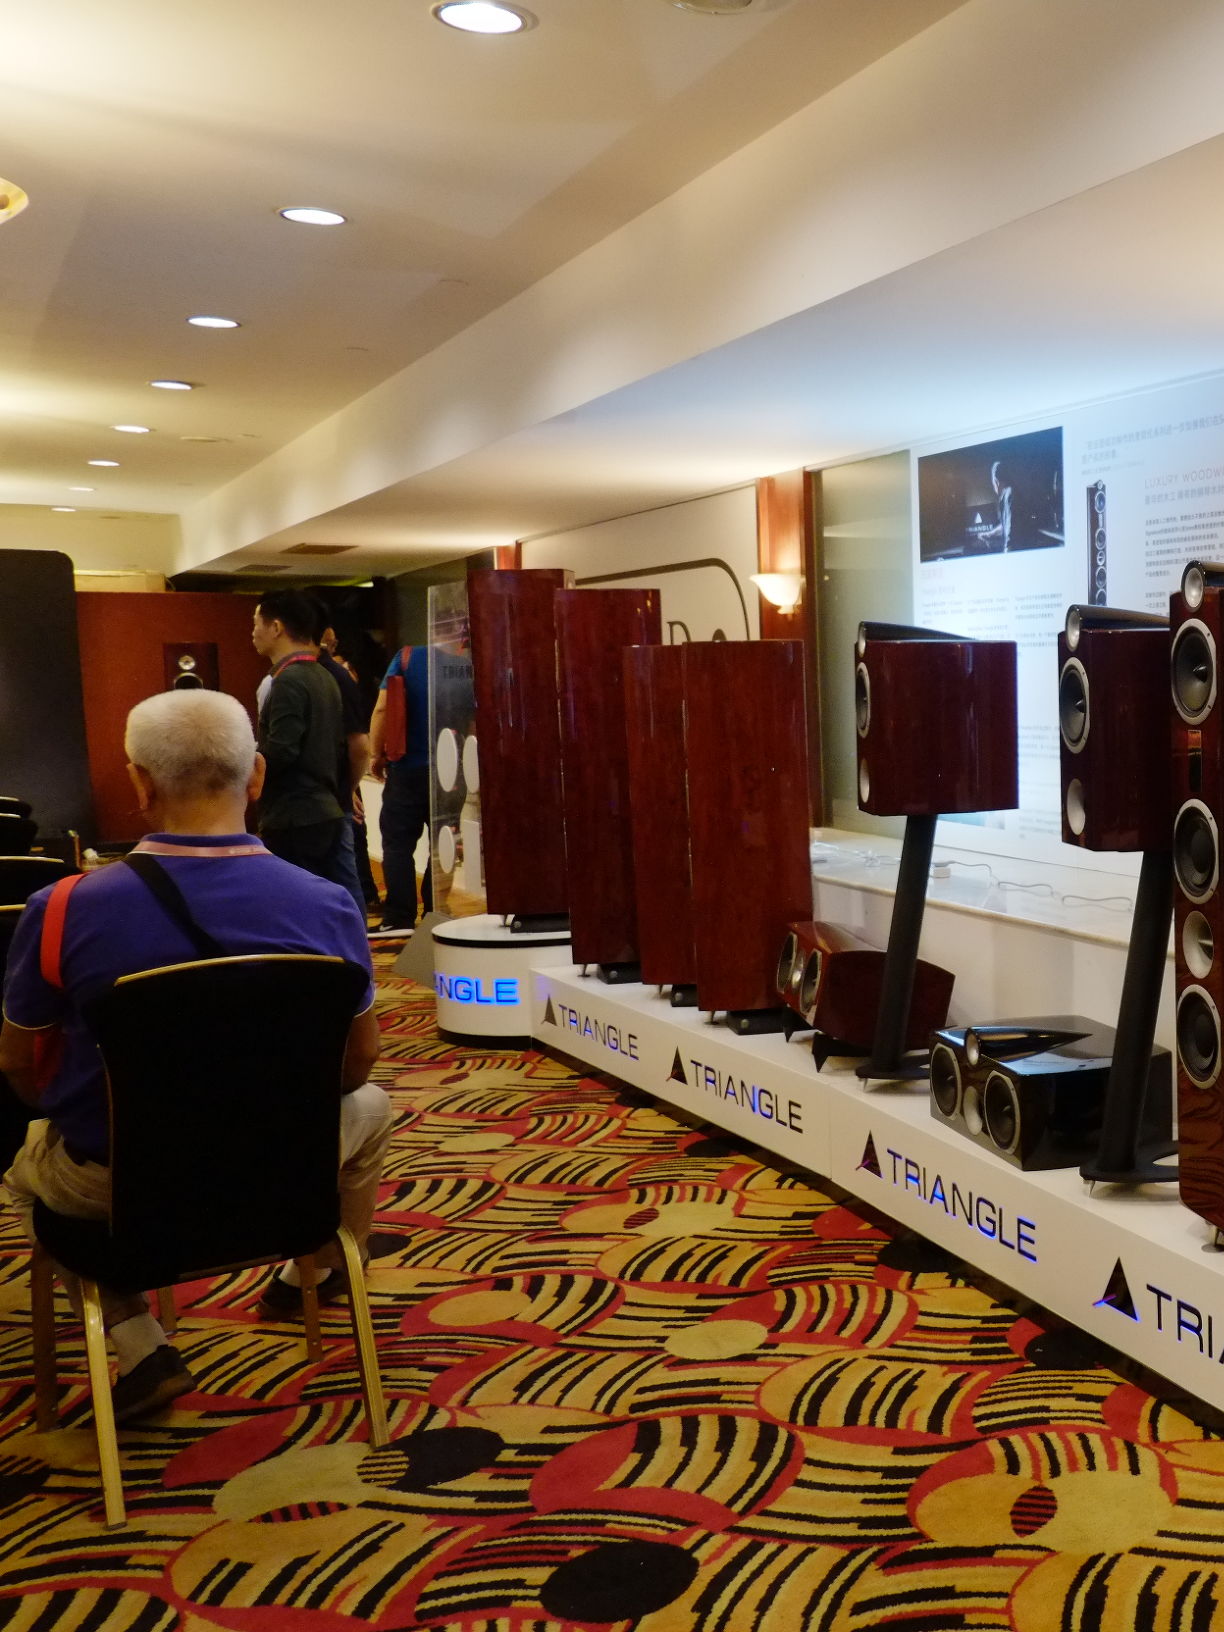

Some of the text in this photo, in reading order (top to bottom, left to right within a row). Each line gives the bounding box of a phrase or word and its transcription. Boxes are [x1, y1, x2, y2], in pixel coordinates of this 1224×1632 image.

[558, 1003, 640, 1061] TRIANGLE
[690, 1059, 804, 1134] TRIANGLE
[886, 1148, 1038, 1264] TRIANGLE
